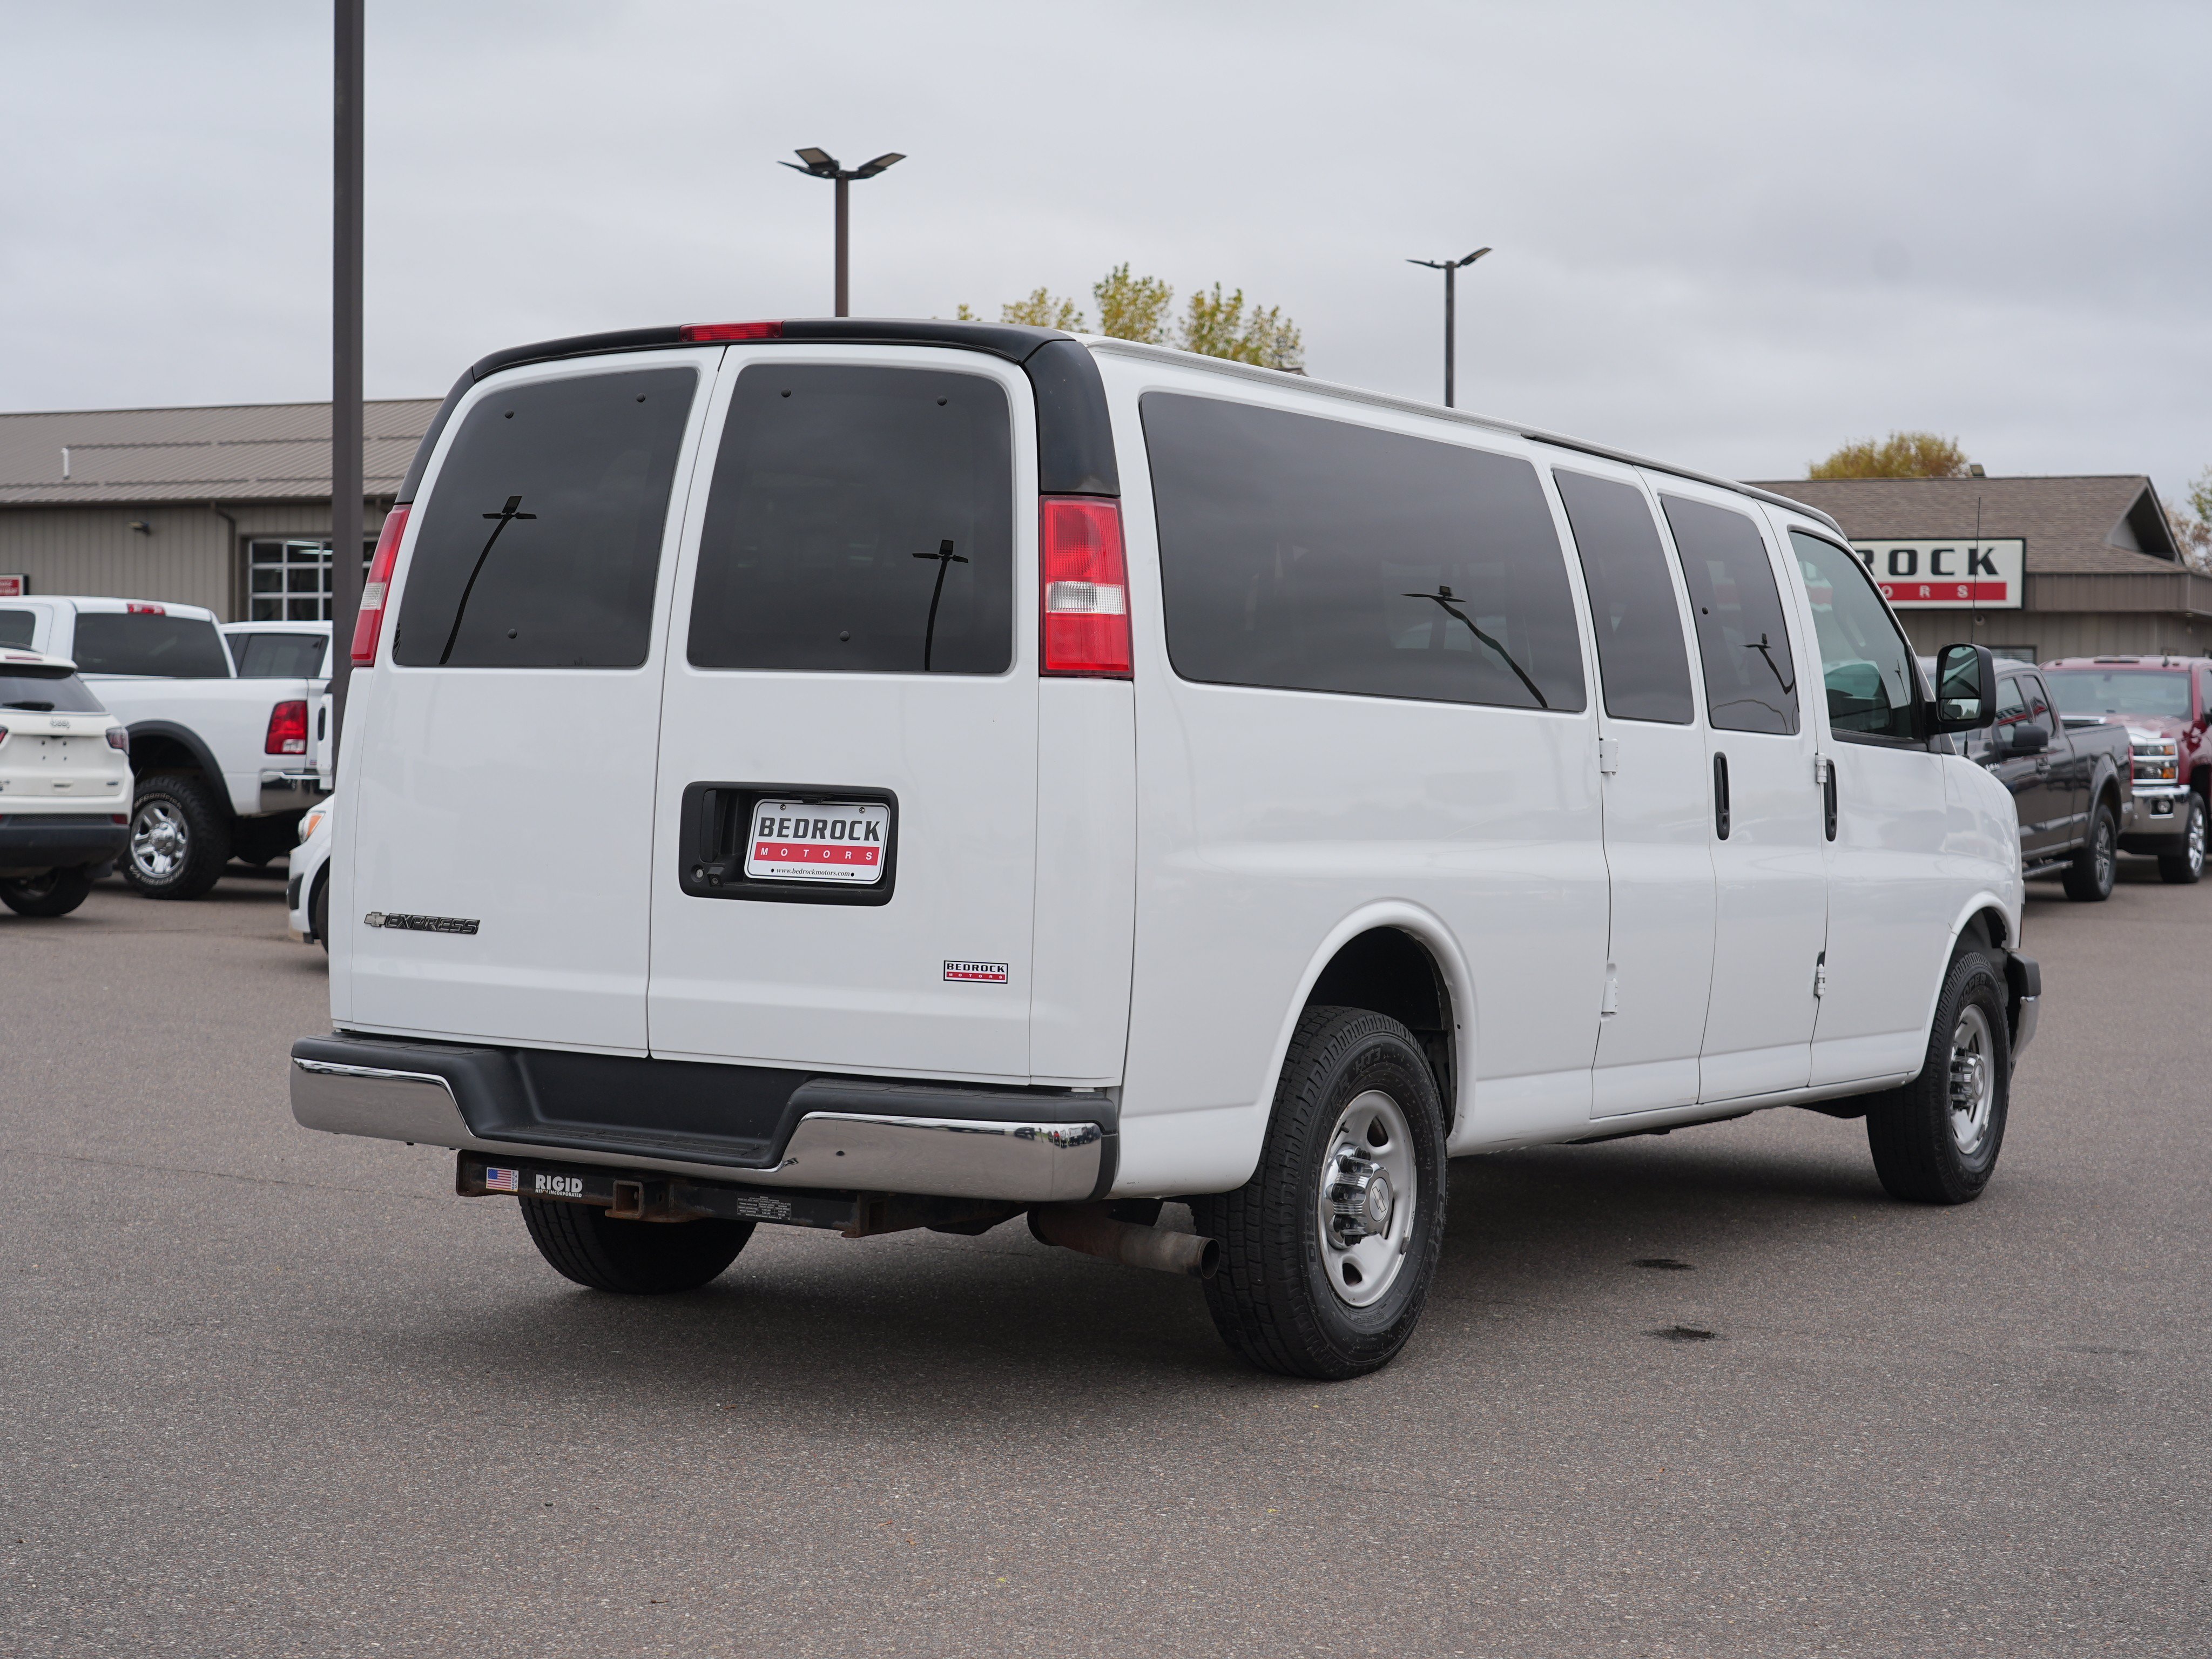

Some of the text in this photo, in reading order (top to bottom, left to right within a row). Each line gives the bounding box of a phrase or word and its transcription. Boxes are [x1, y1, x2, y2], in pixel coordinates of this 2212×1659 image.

[758, 817, 881, 841] BEDROCK
[760, 847, 872, 860] MOTORS
[776, 868, 850, 877] www.bedrockmotors.com
[386, 913, 480, 934] EXPRESS
[947, 963, 1005, 973] BEDROCK
[535, 1174, 583, 1192] RIGID
[549, 1190, 582, 1198] INCORPORATED
